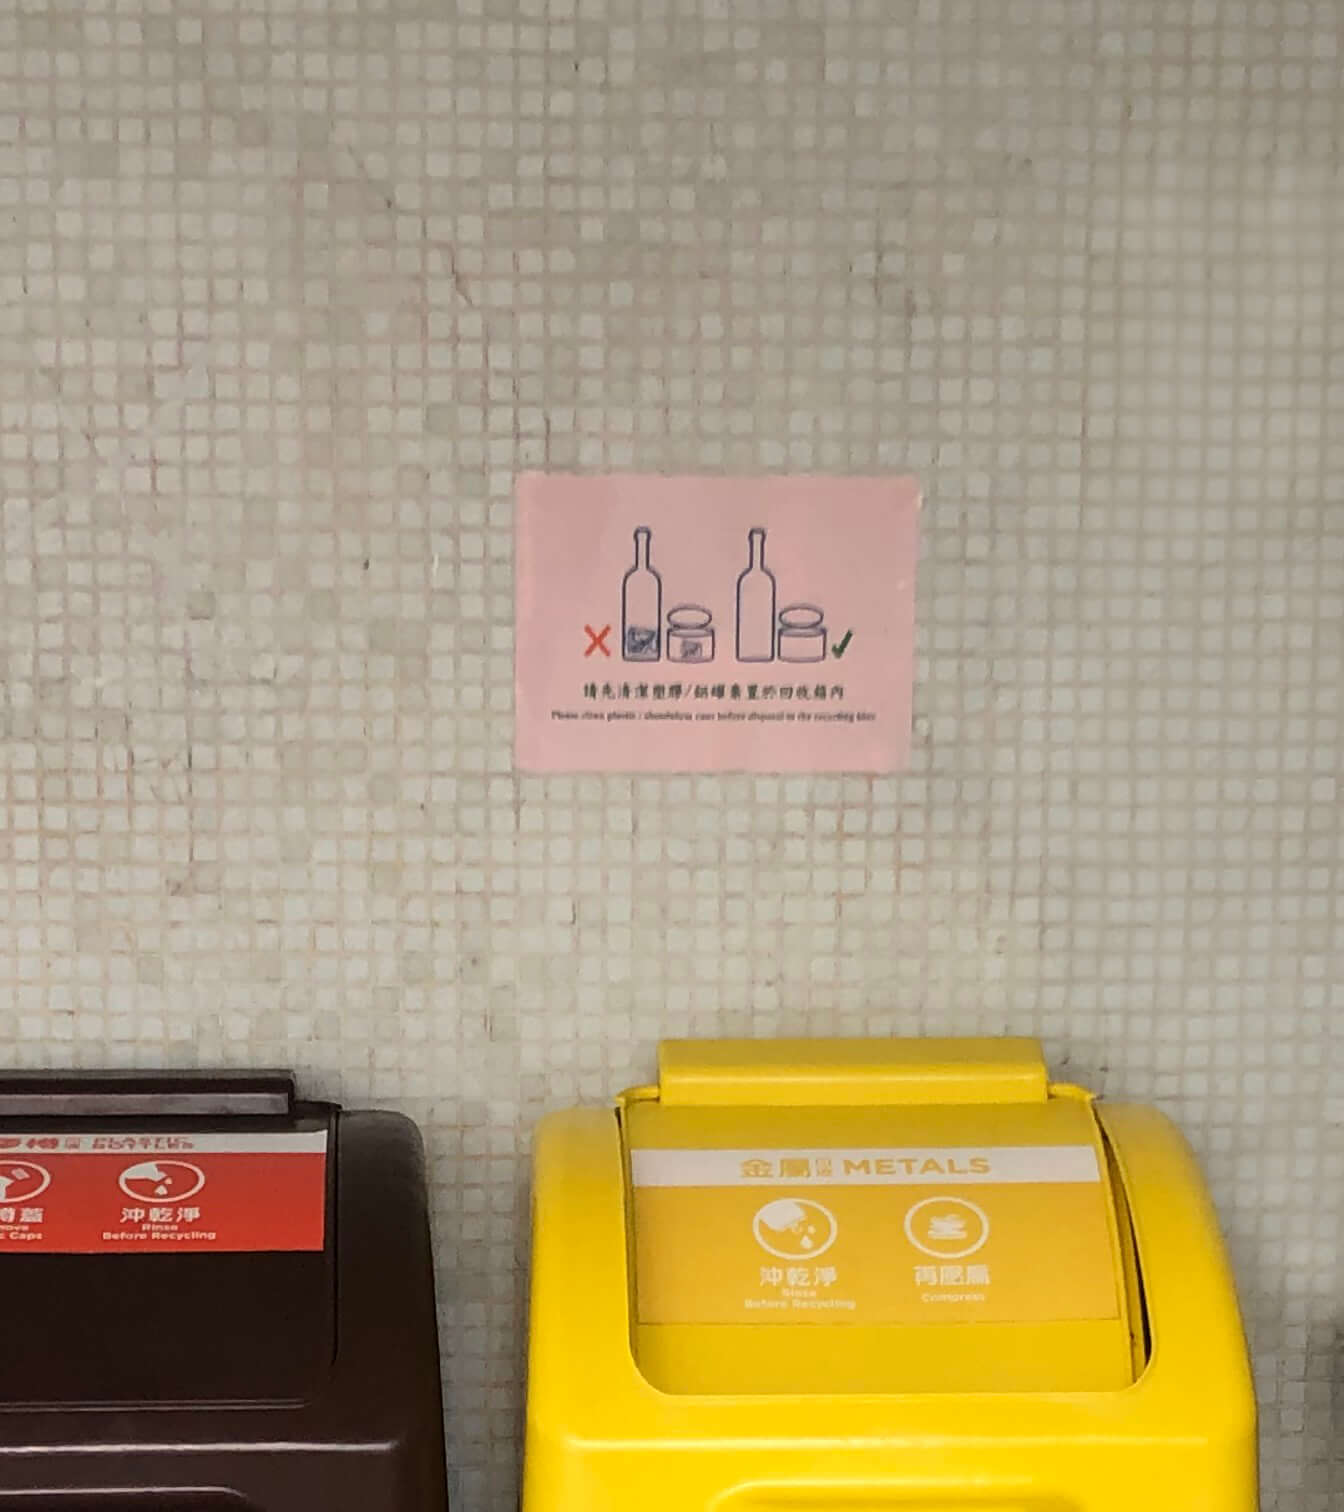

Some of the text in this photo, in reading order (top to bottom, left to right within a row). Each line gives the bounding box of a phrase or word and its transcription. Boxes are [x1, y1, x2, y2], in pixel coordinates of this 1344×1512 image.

[740, 1157, 811, 1178] 金屬
[843, 1156, 991, 1176] METALS
[9, 1231, 43, 1241] Caps
[102, 1231, 217, 1241] Before Recycling
